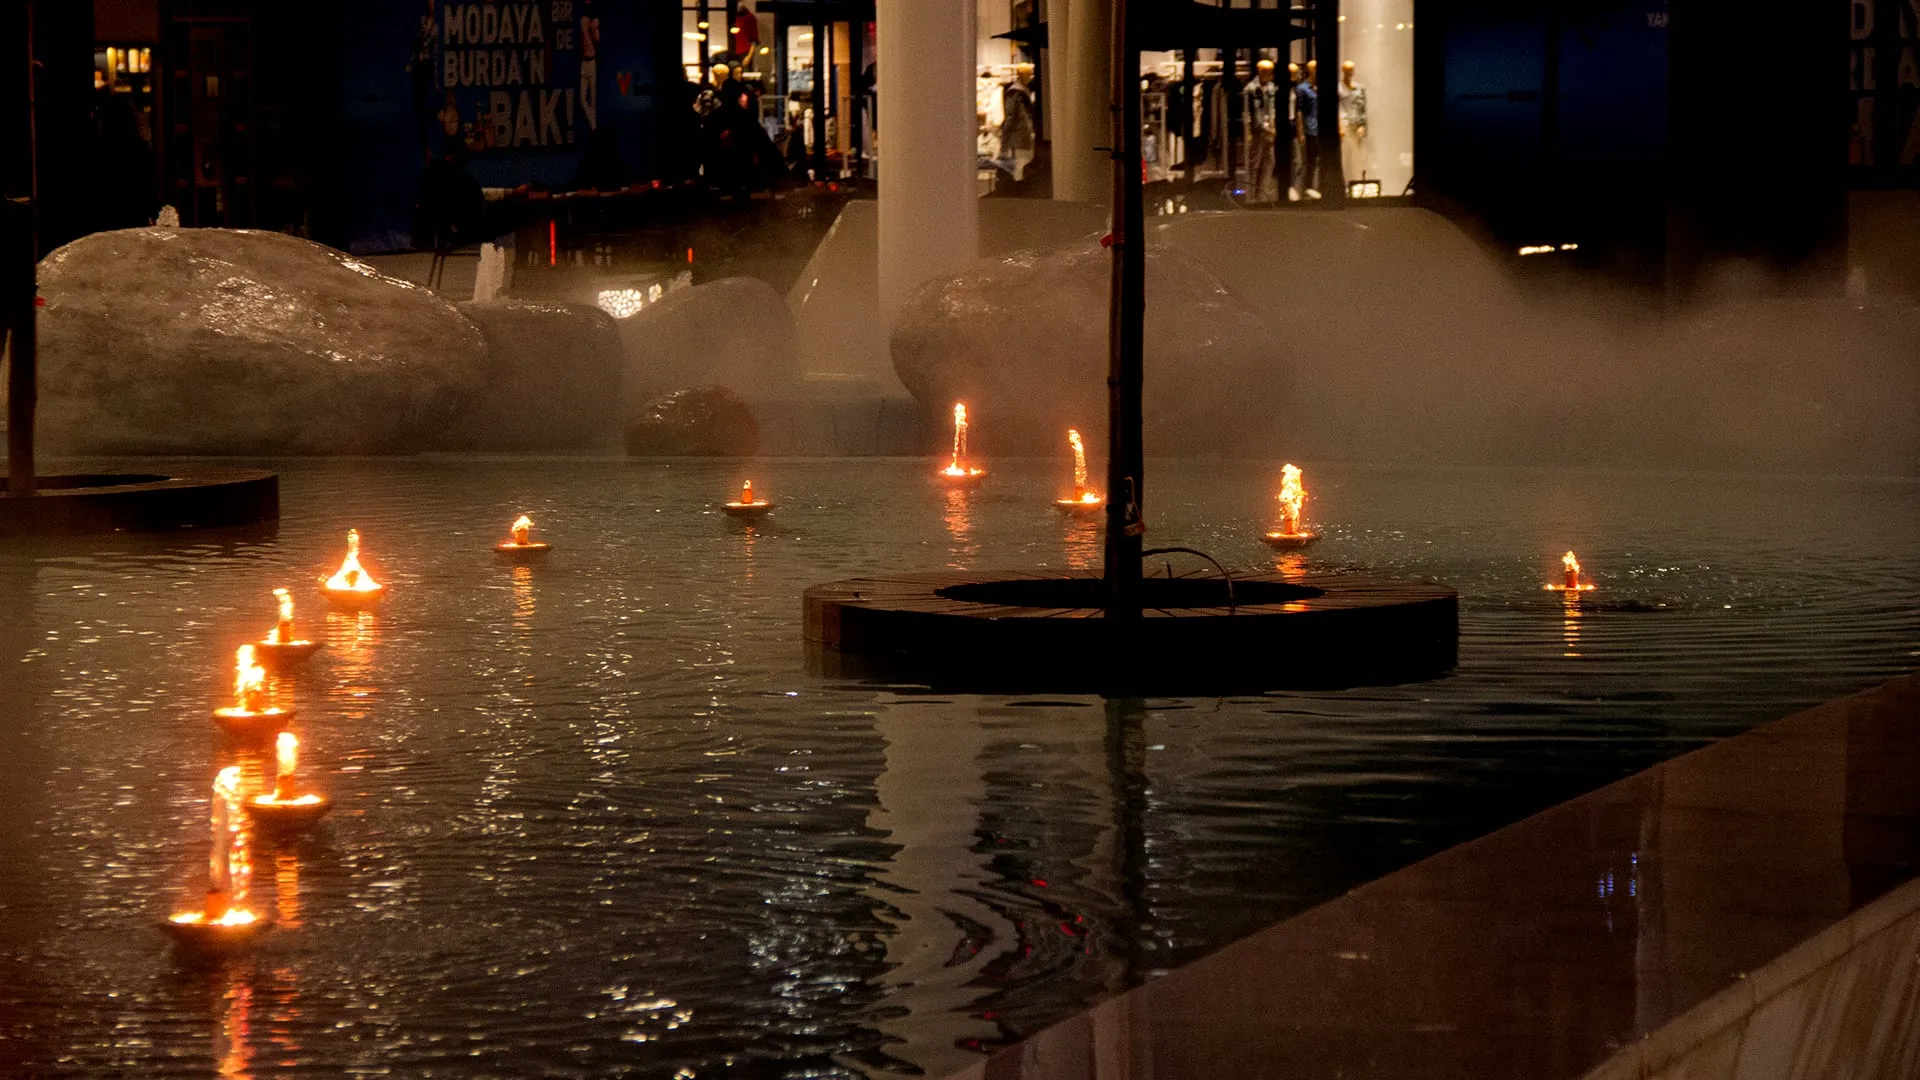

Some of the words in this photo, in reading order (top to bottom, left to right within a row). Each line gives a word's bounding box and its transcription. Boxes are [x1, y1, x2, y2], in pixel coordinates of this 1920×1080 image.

[443, 4, 545, 44] MODAYA
[556, 28, 573, 50] DE
[443, 48, 545, 87] BURDA'N
[489, 88, 574, 148] BAK!
